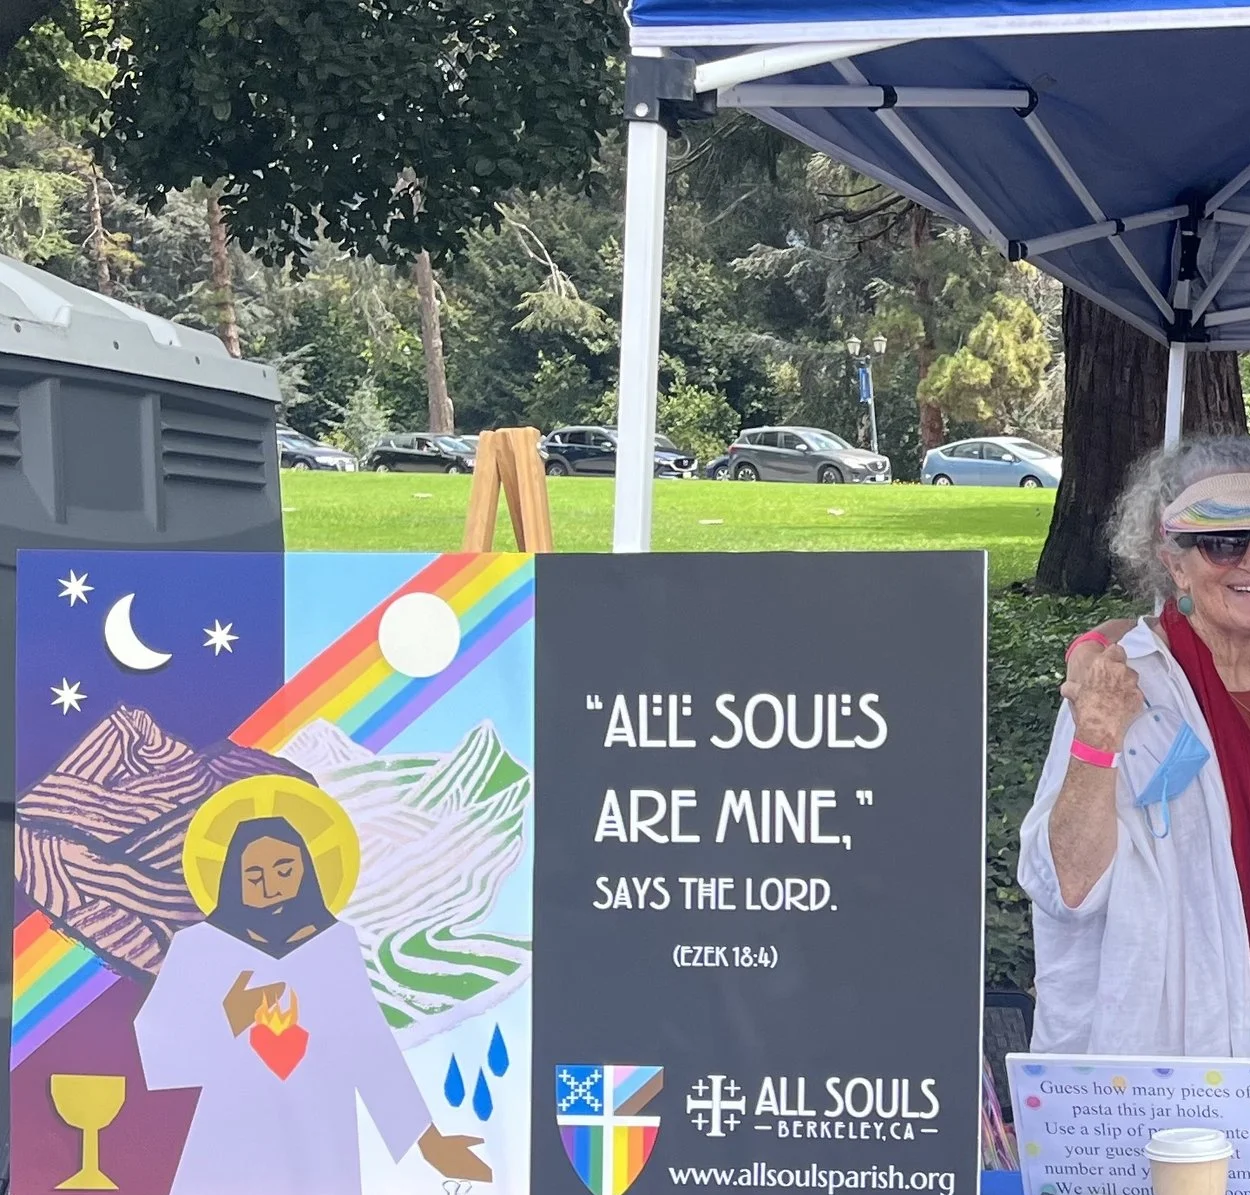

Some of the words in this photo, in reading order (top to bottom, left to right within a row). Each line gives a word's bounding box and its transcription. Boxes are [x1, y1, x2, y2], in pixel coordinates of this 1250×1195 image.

[709, 692, 889, 750] SOULS
[593, 788, 701, 844] ARE
[592, 876, 671, 911] SAYS
[677, 876, 737, 911] THE
[744, 877, 839, 912] LORD.
[672, 944, 729, 969] (EZEK
[732, 944, 779, 969] 18:4)
[754, 1075, 817, 1118] ALL
[824, 1075, 941, 1120] SOULS
[1039, 1079, 1089, 1095] Guess
[1093, 1081, 1127, 1096] how
[1132, 1085, 1176, 1101] many
[1180, 1083, 1230, 1101] pieces
[1072, 1103, 1112, 1119] pasta
[1117, 1102, 1146, 1117] this
[1149, 1103, 1172, 1121] jar
[1176, 1103, 1224, 1119] holds.
[1044, 1121, 1076, 1136] Use
[1080, 1126, 1089, 1136] a
[1093, 1122, 1122, 1140] slip
[1126, 1123, 1145, 1137] of
[1064, 1144, 1101, 1159] your
[1044, 1161, 1104, 1176] number
[1108, 1163, 1137, 1177] and
[1055, 1181, 1083, 1195] We
